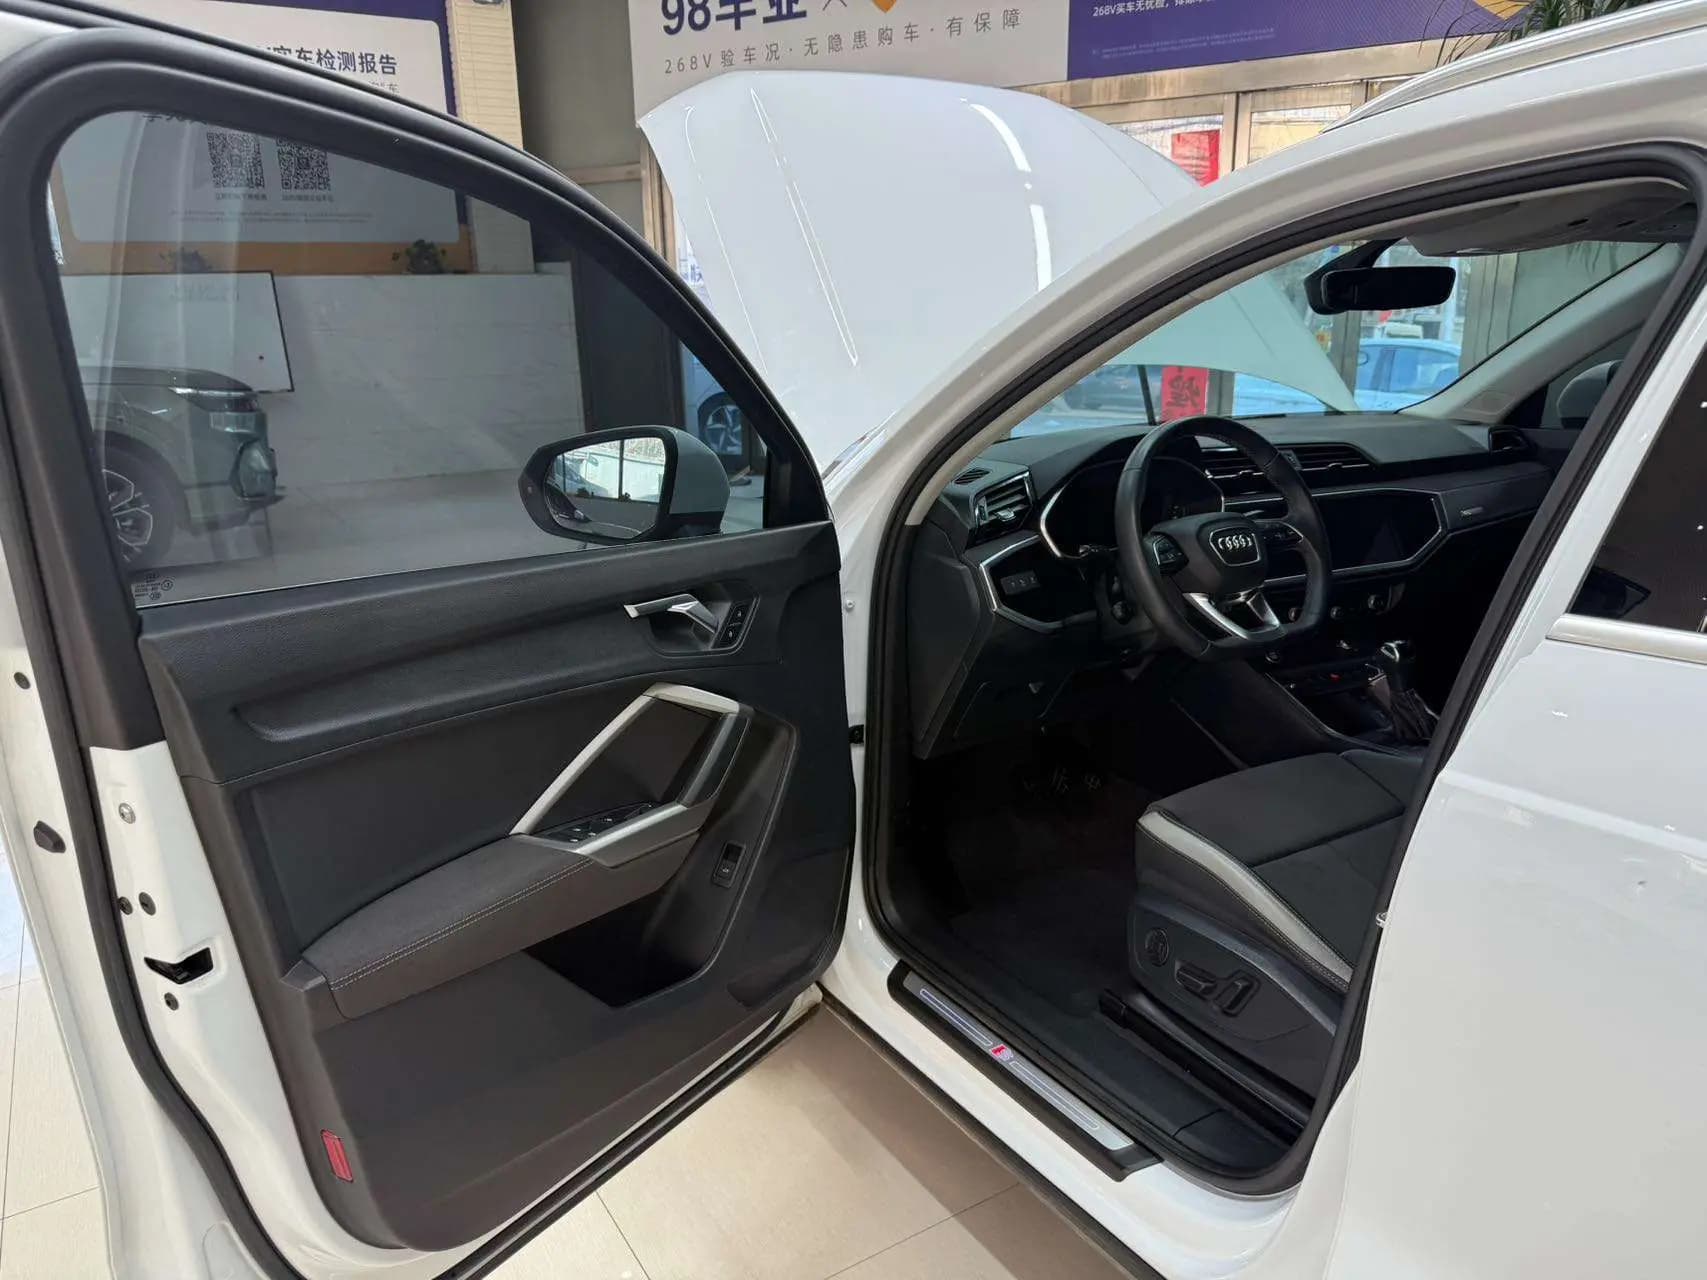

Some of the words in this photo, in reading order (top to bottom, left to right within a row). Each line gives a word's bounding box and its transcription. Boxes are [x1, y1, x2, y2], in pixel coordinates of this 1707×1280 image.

[267, 46, 397, 75] 车检测报告
